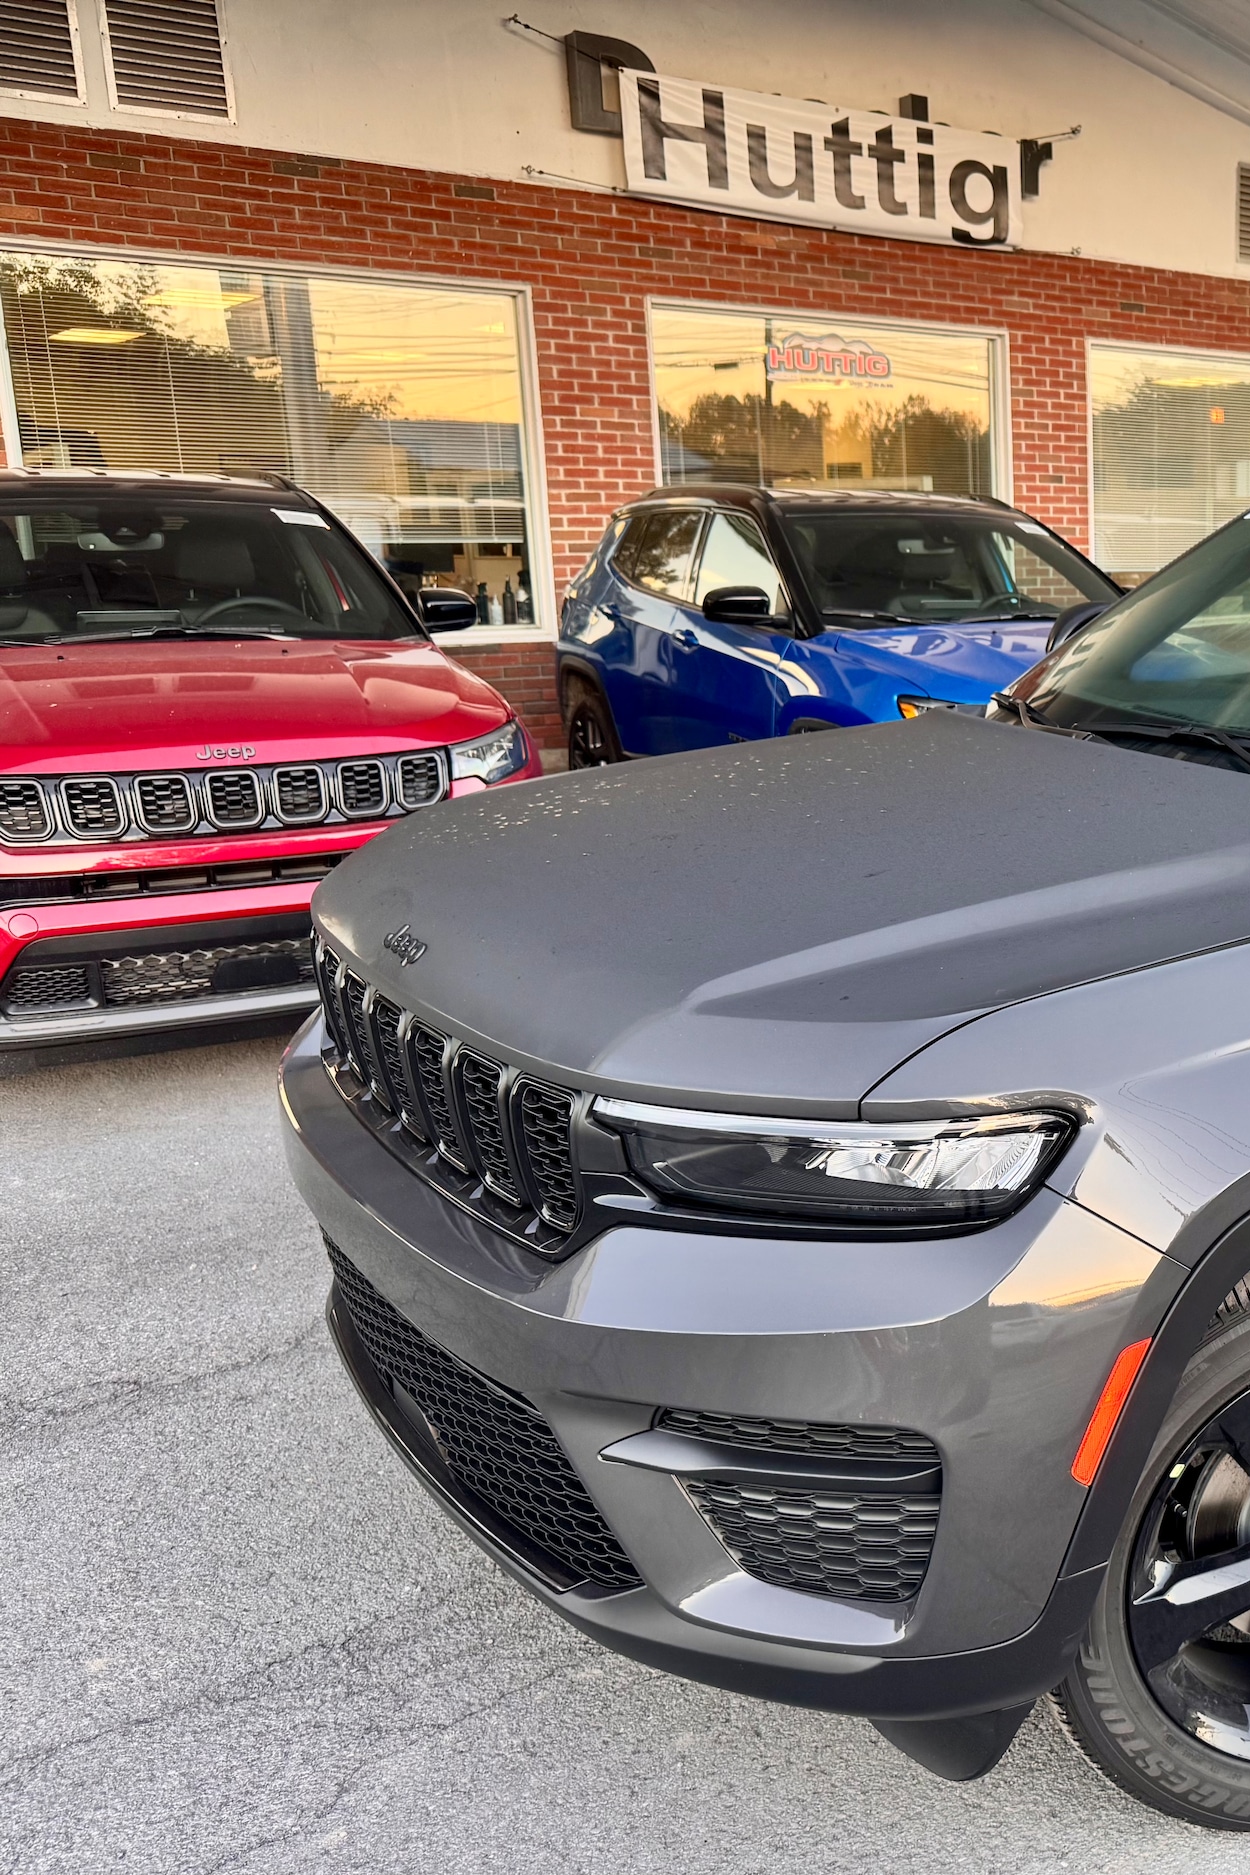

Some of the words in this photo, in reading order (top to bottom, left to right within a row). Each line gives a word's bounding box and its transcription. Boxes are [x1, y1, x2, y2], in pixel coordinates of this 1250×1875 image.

[637, 76, 1009, 245] Huttig
[769, 347, 889, 376] HUTTIG
[196, 744, 256, 761] Jeep
[383, 924, 427, 967] Jeep
